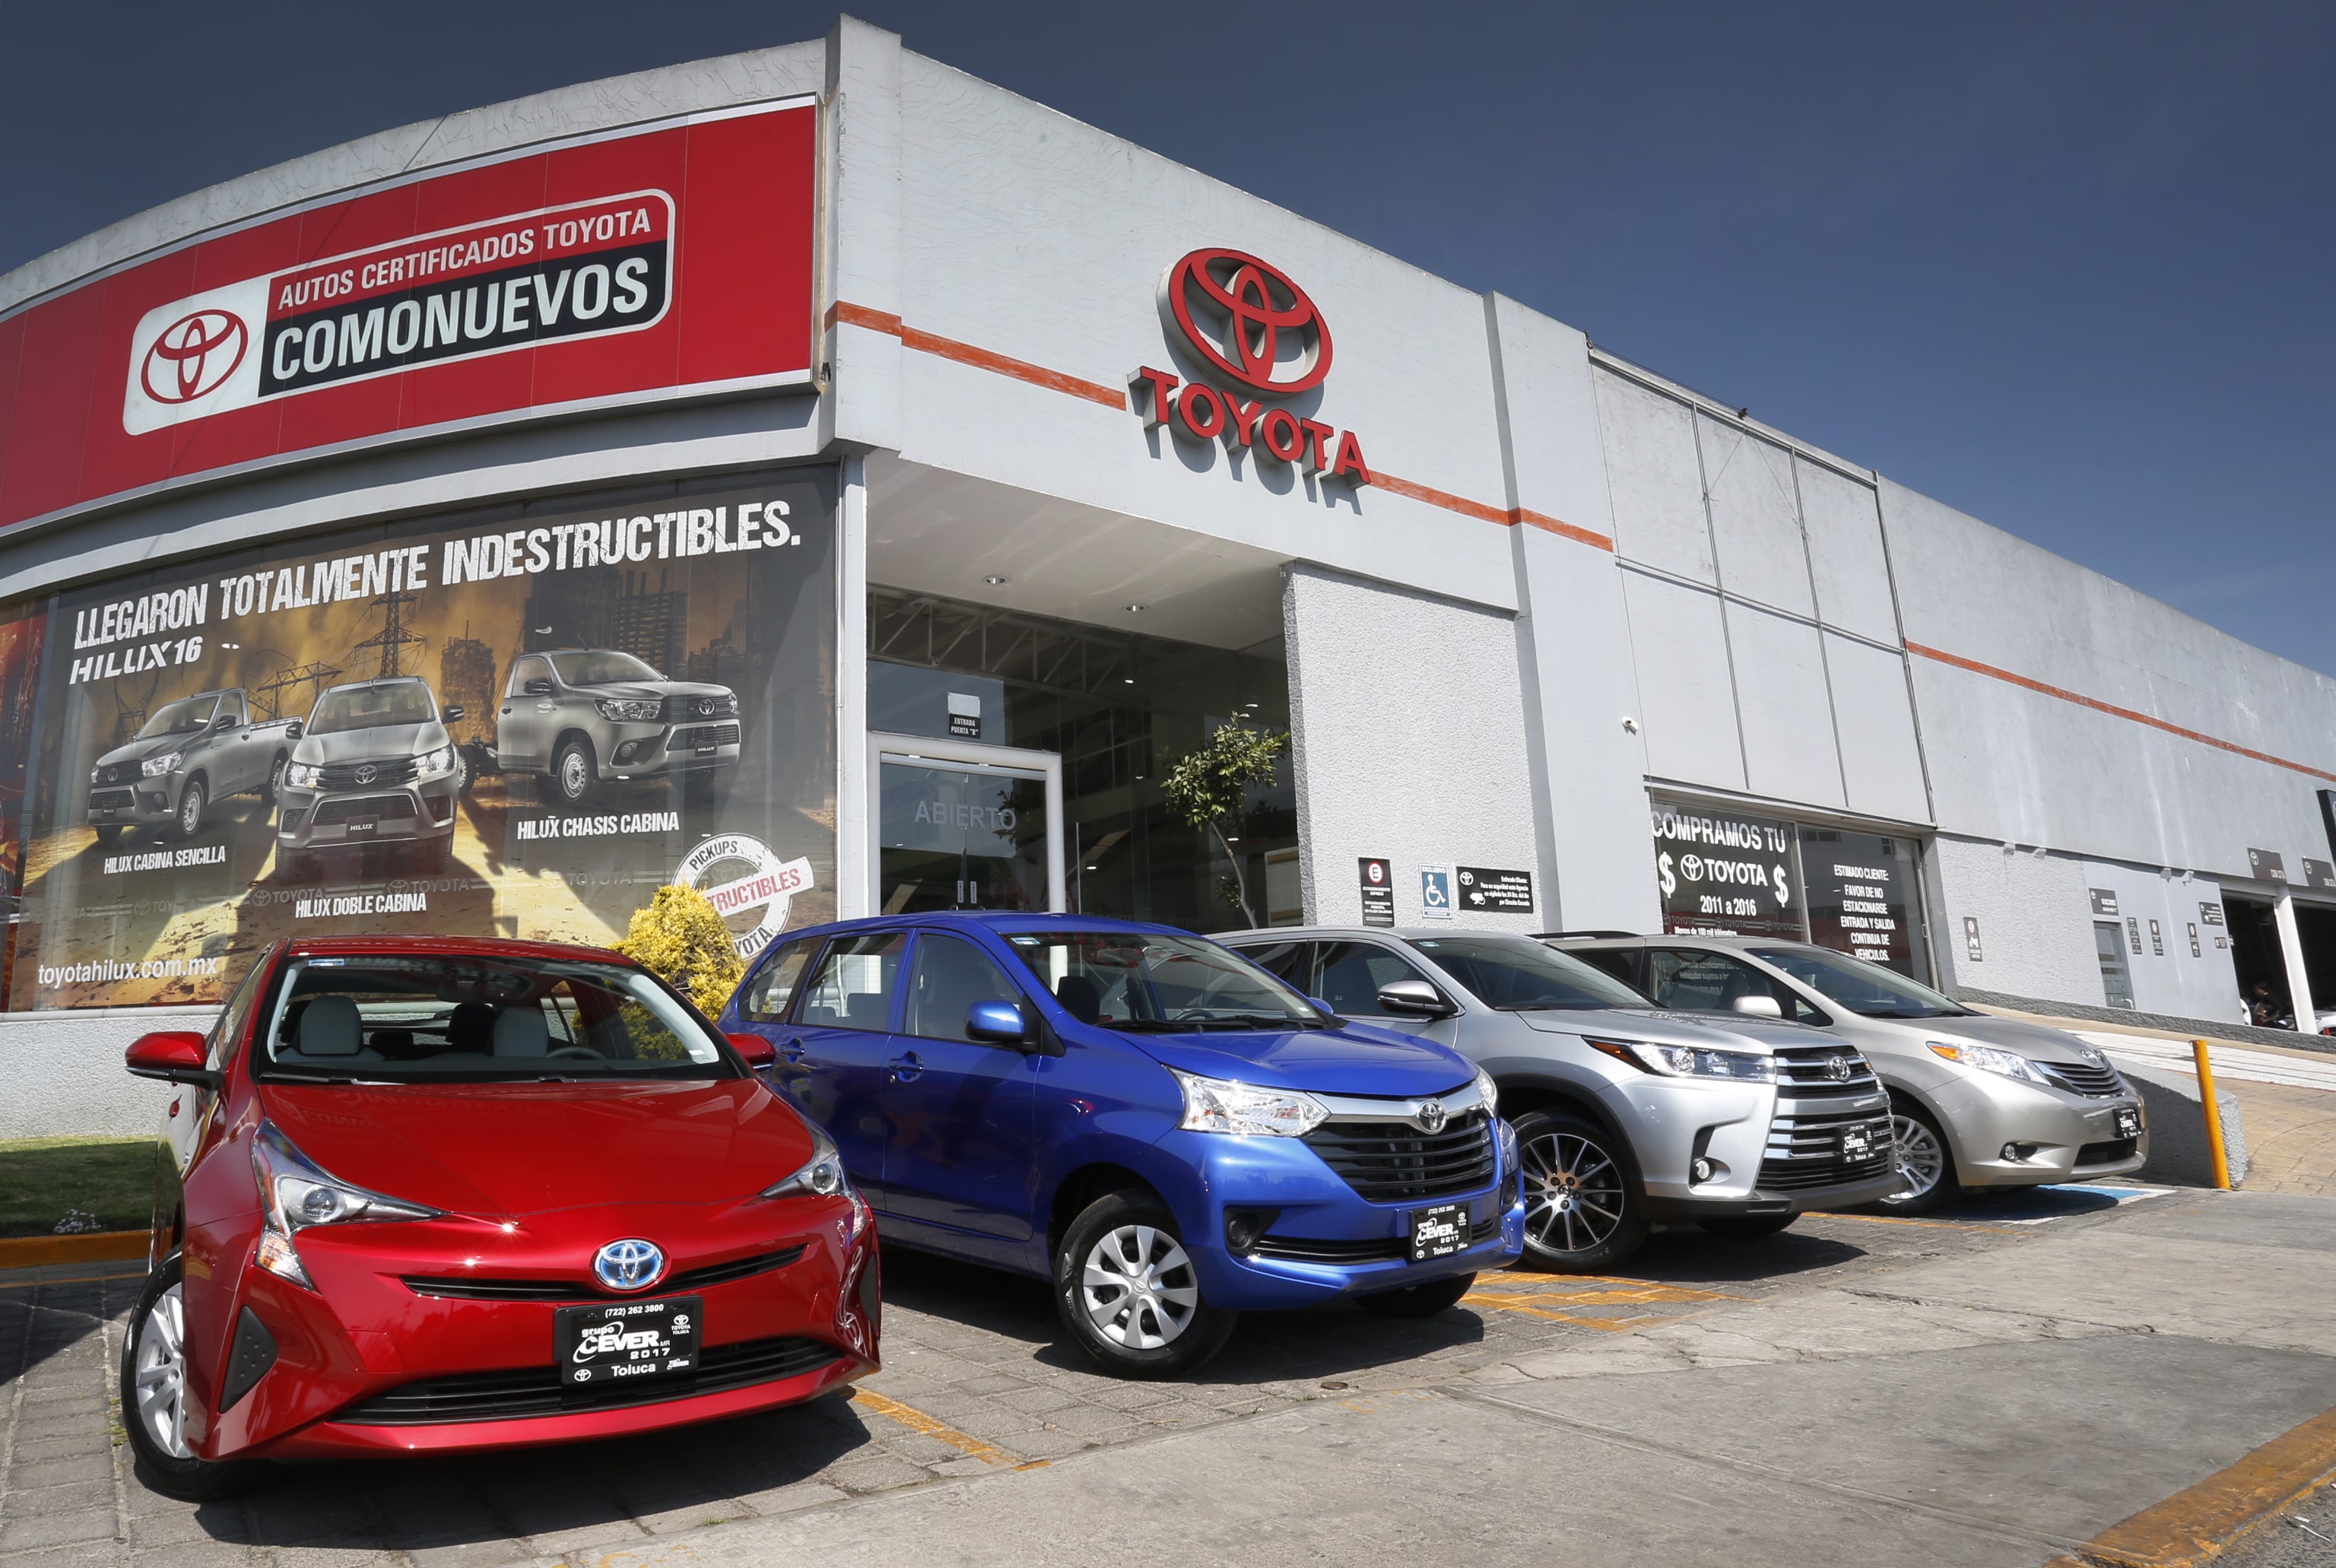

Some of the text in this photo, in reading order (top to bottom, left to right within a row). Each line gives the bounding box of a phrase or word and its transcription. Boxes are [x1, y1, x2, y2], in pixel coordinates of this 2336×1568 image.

[278, 207, 652, 309] AUTOS CERTIFICADOS TOYOTA
[271, 256, 650, 380] COMONUEVOS
[1133, 365, 1371, 488] TOYOTA
[74, 500, 801, 649] LLEGARON TOTALMENTE INDESTRUCTIBLES.
[69, 640, 173, 684] HILUX
[951, 725, 969, 735] PUERTA
[954, 717, 976, 727] ENTRADA
[914, 800, 1016, 830] ABIERTO
[350, 823, 373, 831] HILUX
[517, 811, 680, 840] HILUX CHASIS CABINA
[1651, 811, 1785, 853] COMPRAMOS TU
[103, 845, 226, 874] HILUX CABINA SENCILLA
[689, 840, 738, 871] PICKUPS
[1372, 867, 1379, 879] E
[1658, 851, 1788, 908] $ TOYOTA $
[1833, 864, 1889, 881] ESTIMADO CLIENTE:
[411, 878, 469, 894] TOYOTA
[1844, 884, 1884, 899] FAVOR DE NO
[272, 887, 323, 903] TOYOTA
[295, 892, 427, 919] HILUX DOBLE CABINA
[1700, 895, 1757, 916] 2011 a 2016
[1842, 900, 1888, 914] ESTACIONARSE
[1671, 916, 1695, 925] TOYOTA
[1724, 919, 1747, 928] TOYOTA
[1840, 916, 1896, 930] ENTRADA Y SALIDA
[1674, 926, 1690, 935] Menos
[1698, 927, 1706, 936] 100
[1850, 932, 1890, 945] CONTINUA DE
[1855, 948, 1890, 961] VEHICULOS.
[38, 957, 218, 989] toyotahilux.com.mx
[1417, 1221, 1433, 1230] grupo
[1418, 1224, 1454, 1240] CEVER
[1440, 1235, 1459, 1244] 2017
[1433, 1246, 1453, 1255] Toluca
[605, 1304, 664, 1318] (722) 262 3800
[581, 1326, 614, 1338] grupo
[578, 1331, 660, 1354] CEVER
[630, 1347, 671, 1360] 2017
[611, 1363, 656, 1377] Toluca
